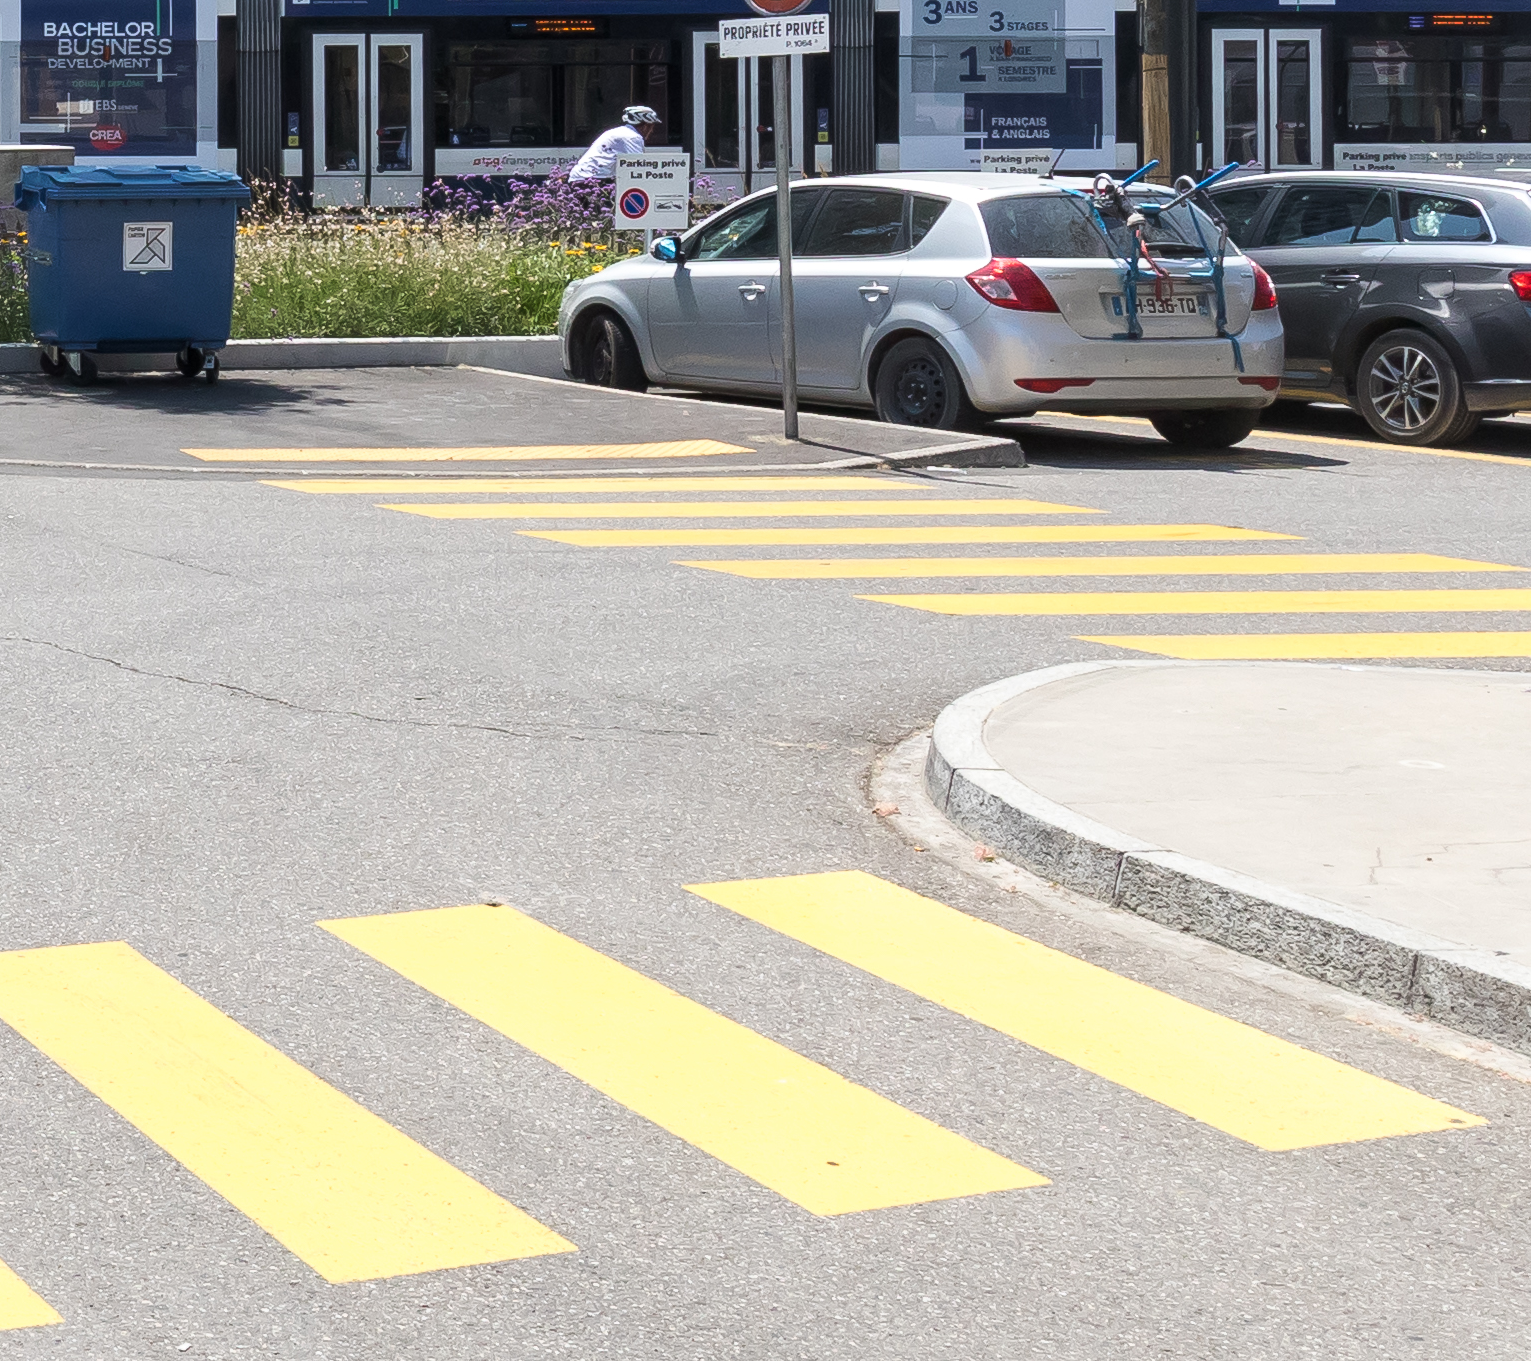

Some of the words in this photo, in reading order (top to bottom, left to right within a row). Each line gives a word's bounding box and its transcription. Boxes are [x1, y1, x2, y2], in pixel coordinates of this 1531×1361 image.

[922, 0, 943, 25] 3
[944, 0, 979, 14] ANS
[989, 10, 1005, 32] 3
[1007, 21, 1049, 32] STAGES
[43, 22, 155, 37] BACHELOR
[723, 22, 782, 40] PROPRIÉTÉ
[786, 19, 825, 36] PRIVÉE
[48, 58, 151, 69] DEVELOPMENT
[959, 45, 987, 82] 1
[989, 45, 1032, 55] VOAGE
[998, 65, 1057, 76] SEMESTRE
[95, 99, 117, 111] EBS
[991, 117, 1048, 128] FRANÇAIS
[89, 129, 123, 141] CREA
[991, 129, 1000, 138] &
[1002, 129, 1050, 139] ANGLAIS
[983, 155, 1022, 165] Parking
[1025, 154, 1050, 165] privé
[1342, 151, 1380, 161] Parking
[619, 158, 659, 169] Parking
[662, 157, 686, 169] privé
[630, 171, 643, 179] La
[645, 171, 674, 179] Poste
